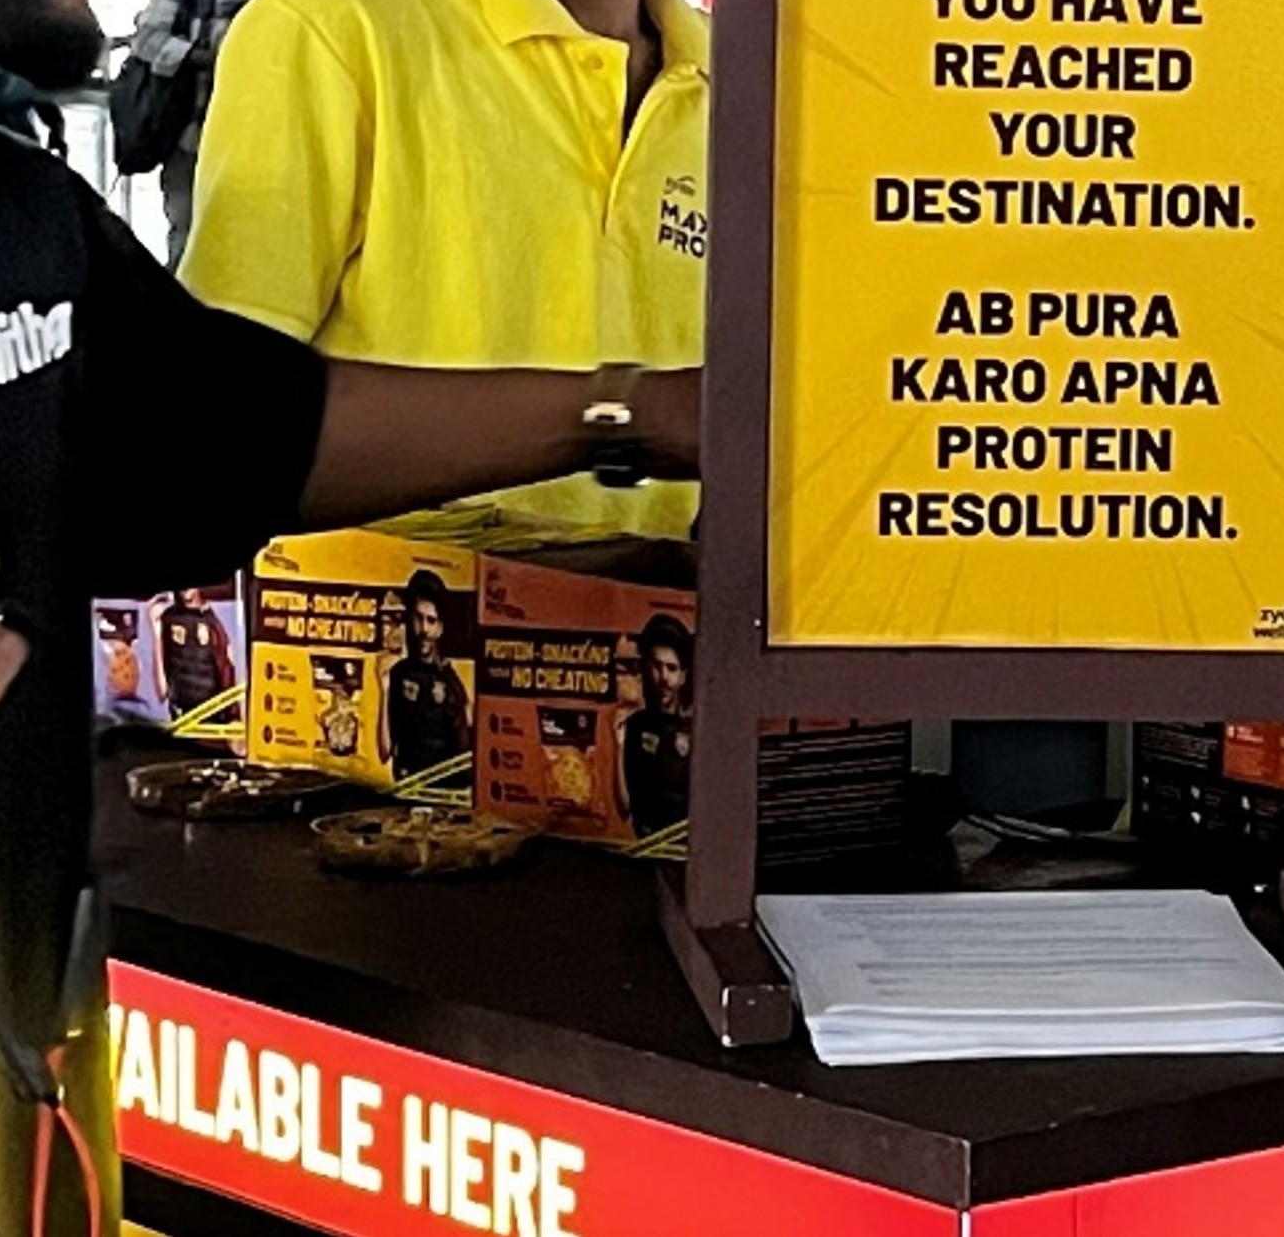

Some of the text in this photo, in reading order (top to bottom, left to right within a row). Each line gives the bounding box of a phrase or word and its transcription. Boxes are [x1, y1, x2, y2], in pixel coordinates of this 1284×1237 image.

[934, 43, 1192, 92] REACHED
[989, 112, 1137, 159] YOUR
[875, 178, 1256, 229] DESTINATION.
[658, 223, 706, 259] PRO
[935, 291, 1180, 339] AB PURA
[891, 358, 1220, 407] KARO APNA
[937, 426, 1172, 472] PROTEIN
[878, 492, 1238, 540] RESOLUTION.
[107, 1004, 585, 1237] AILABLE HERE
